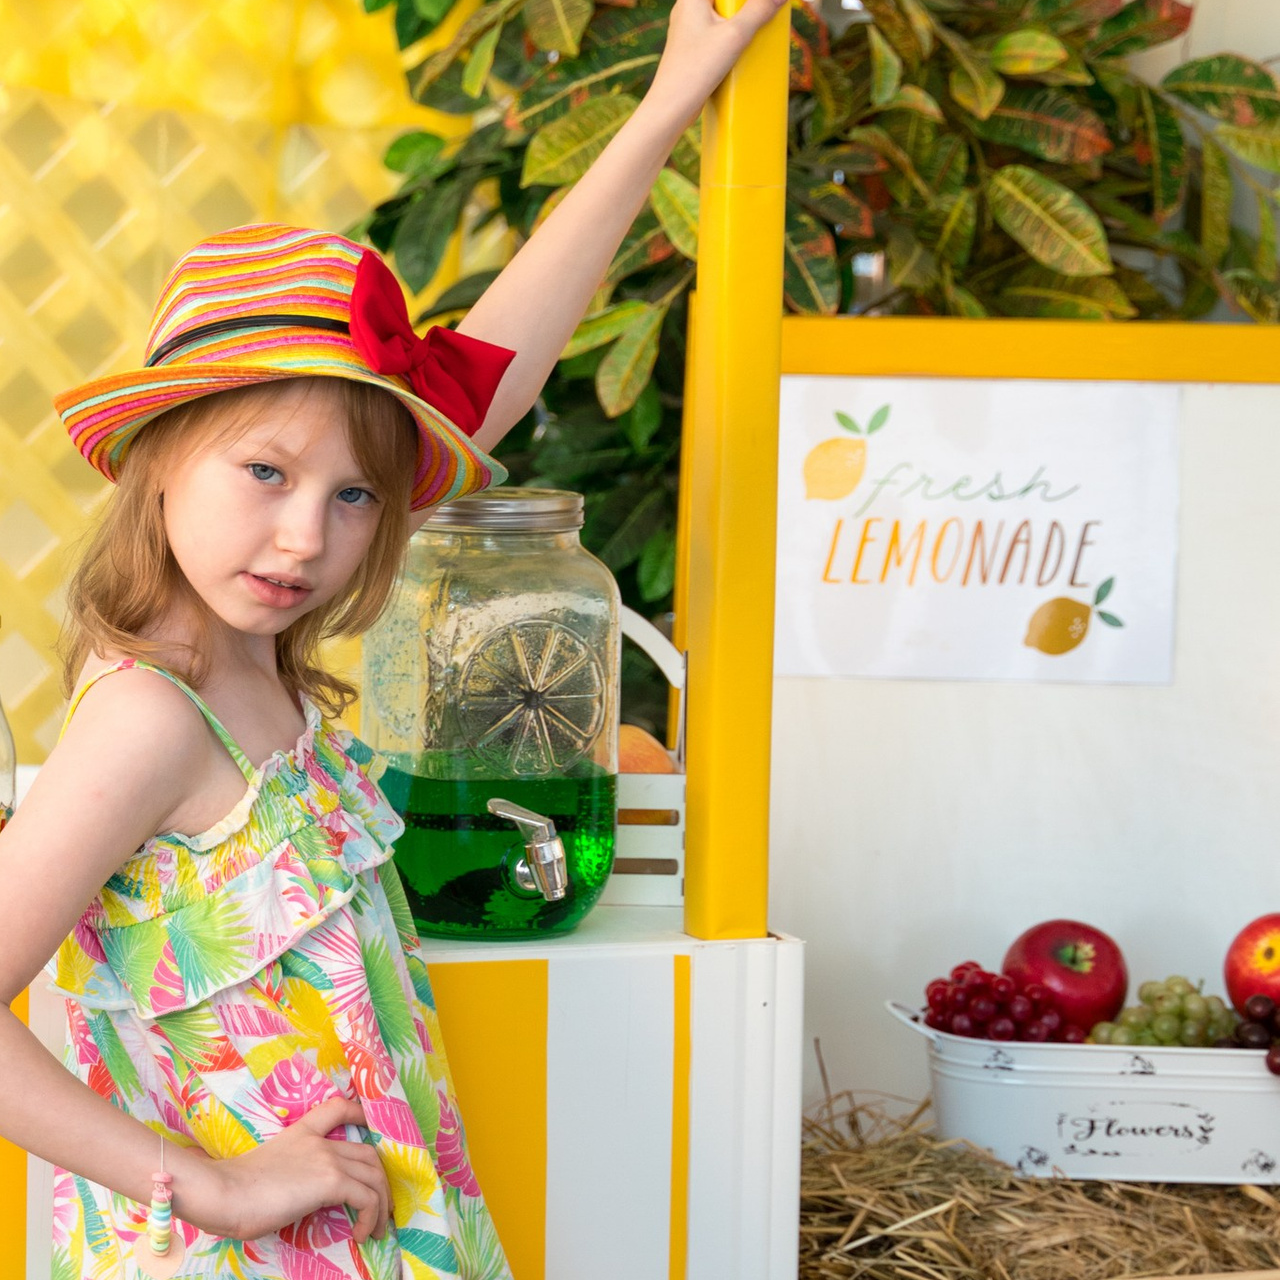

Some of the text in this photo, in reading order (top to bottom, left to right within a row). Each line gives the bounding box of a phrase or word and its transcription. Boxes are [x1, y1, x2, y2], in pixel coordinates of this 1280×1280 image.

[854, 461, 1082, 519] fresh
[822, 517, 1102, 588] LEMONADE
[1070, 1117, 1195, 1142] Flowers
